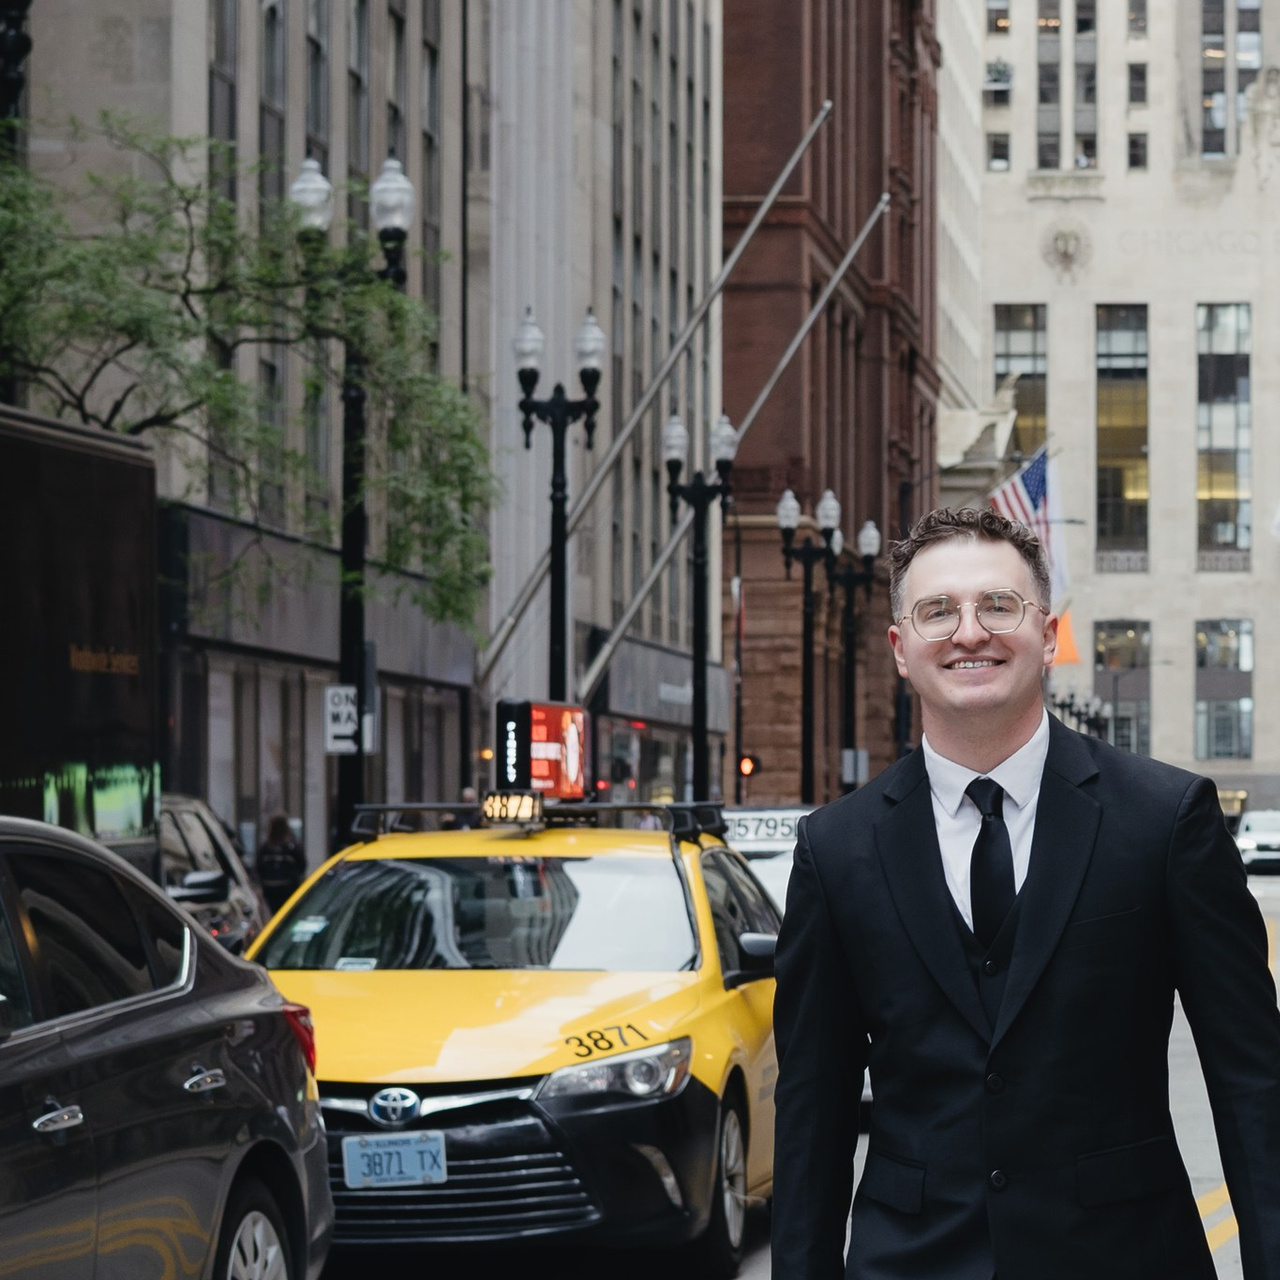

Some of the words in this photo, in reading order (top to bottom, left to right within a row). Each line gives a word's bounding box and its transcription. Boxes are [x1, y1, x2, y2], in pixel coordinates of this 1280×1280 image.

[1117, 230, 1261, 255] CHICAGO
[329, 691, 359, 707] ON
[330, 710, 359, 727] WA
[565, 1024, 649, 1058] 3871
[361, 1149, 405, 1178] 3871
[417, 1147, 443, 1171] TX
